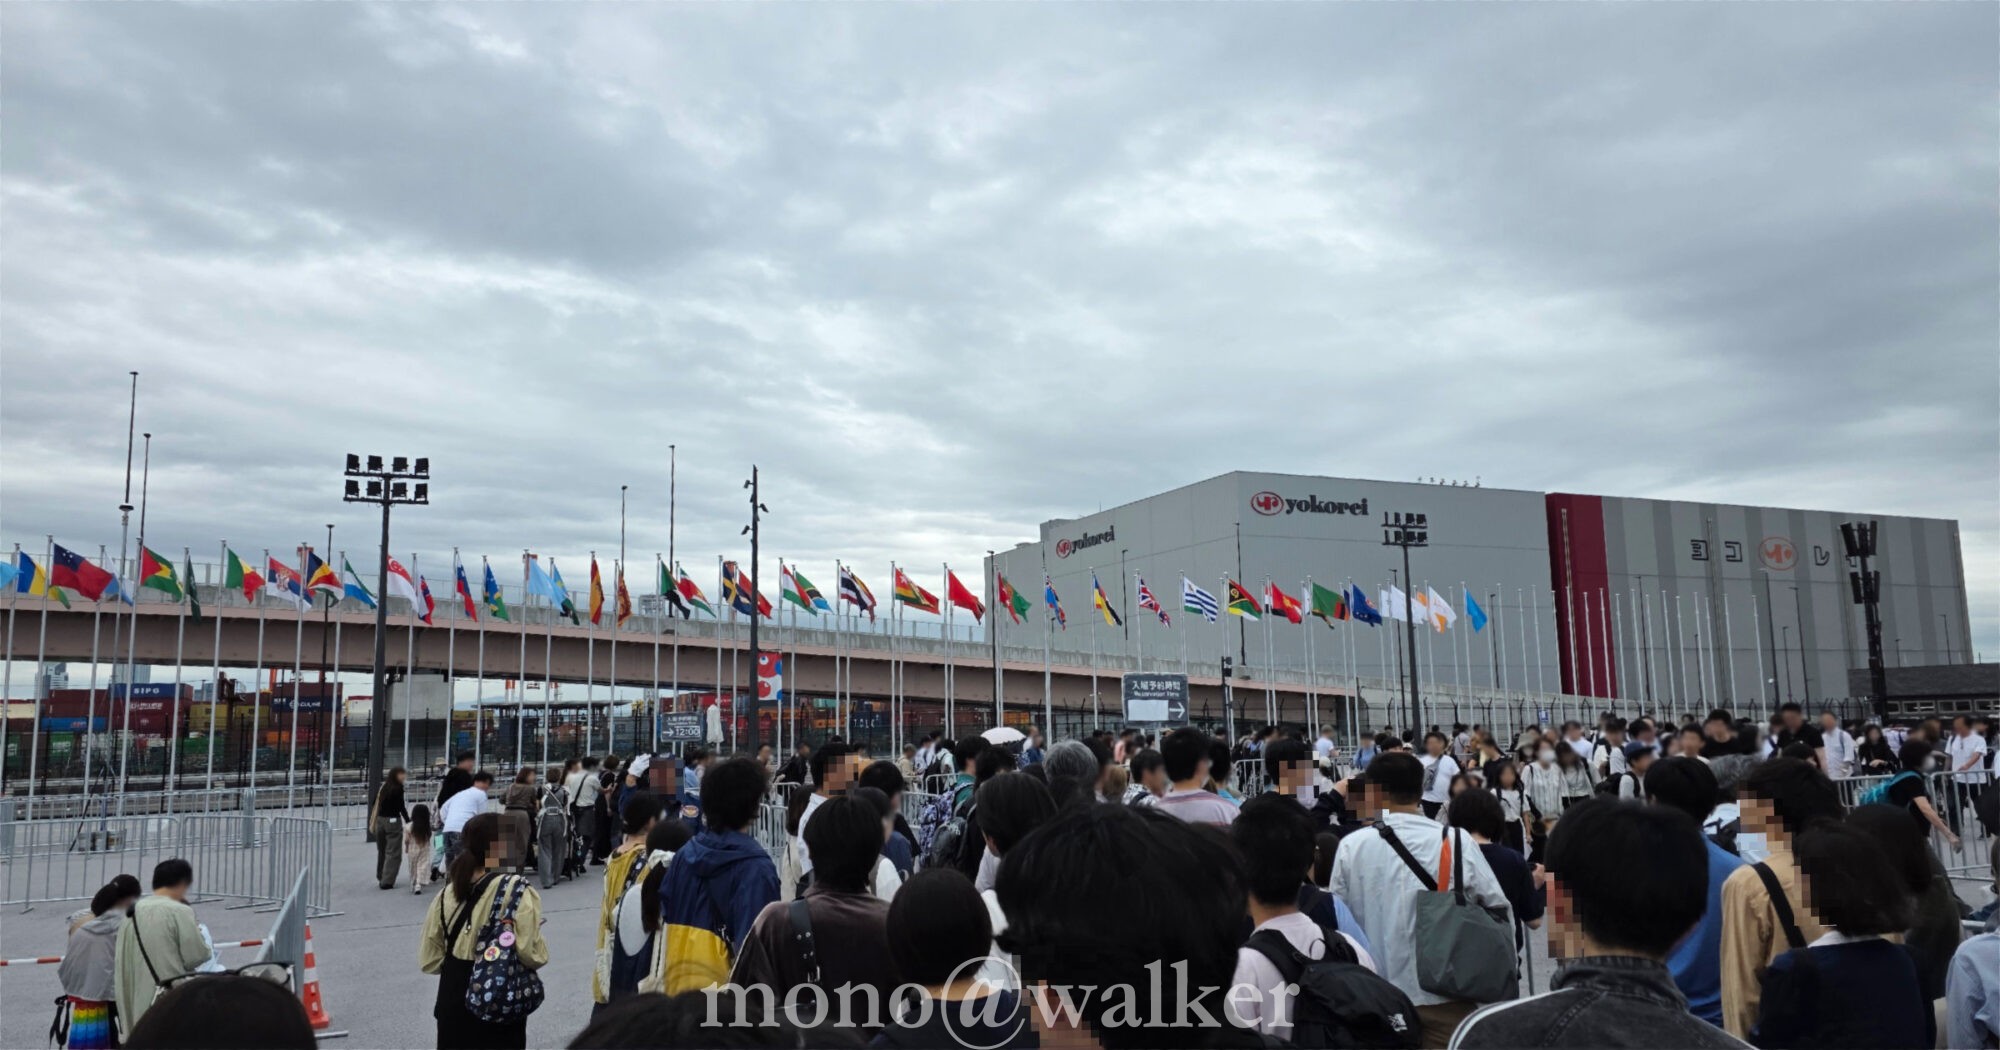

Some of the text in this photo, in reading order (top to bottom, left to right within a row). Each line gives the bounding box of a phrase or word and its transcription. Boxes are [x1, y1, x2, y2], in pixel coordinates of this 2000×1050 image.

[1285, 494, 1369, 516] yokorei
[1071, 525, 1115, 555] yokorei
[675, 727, 700, 737] 12:00
